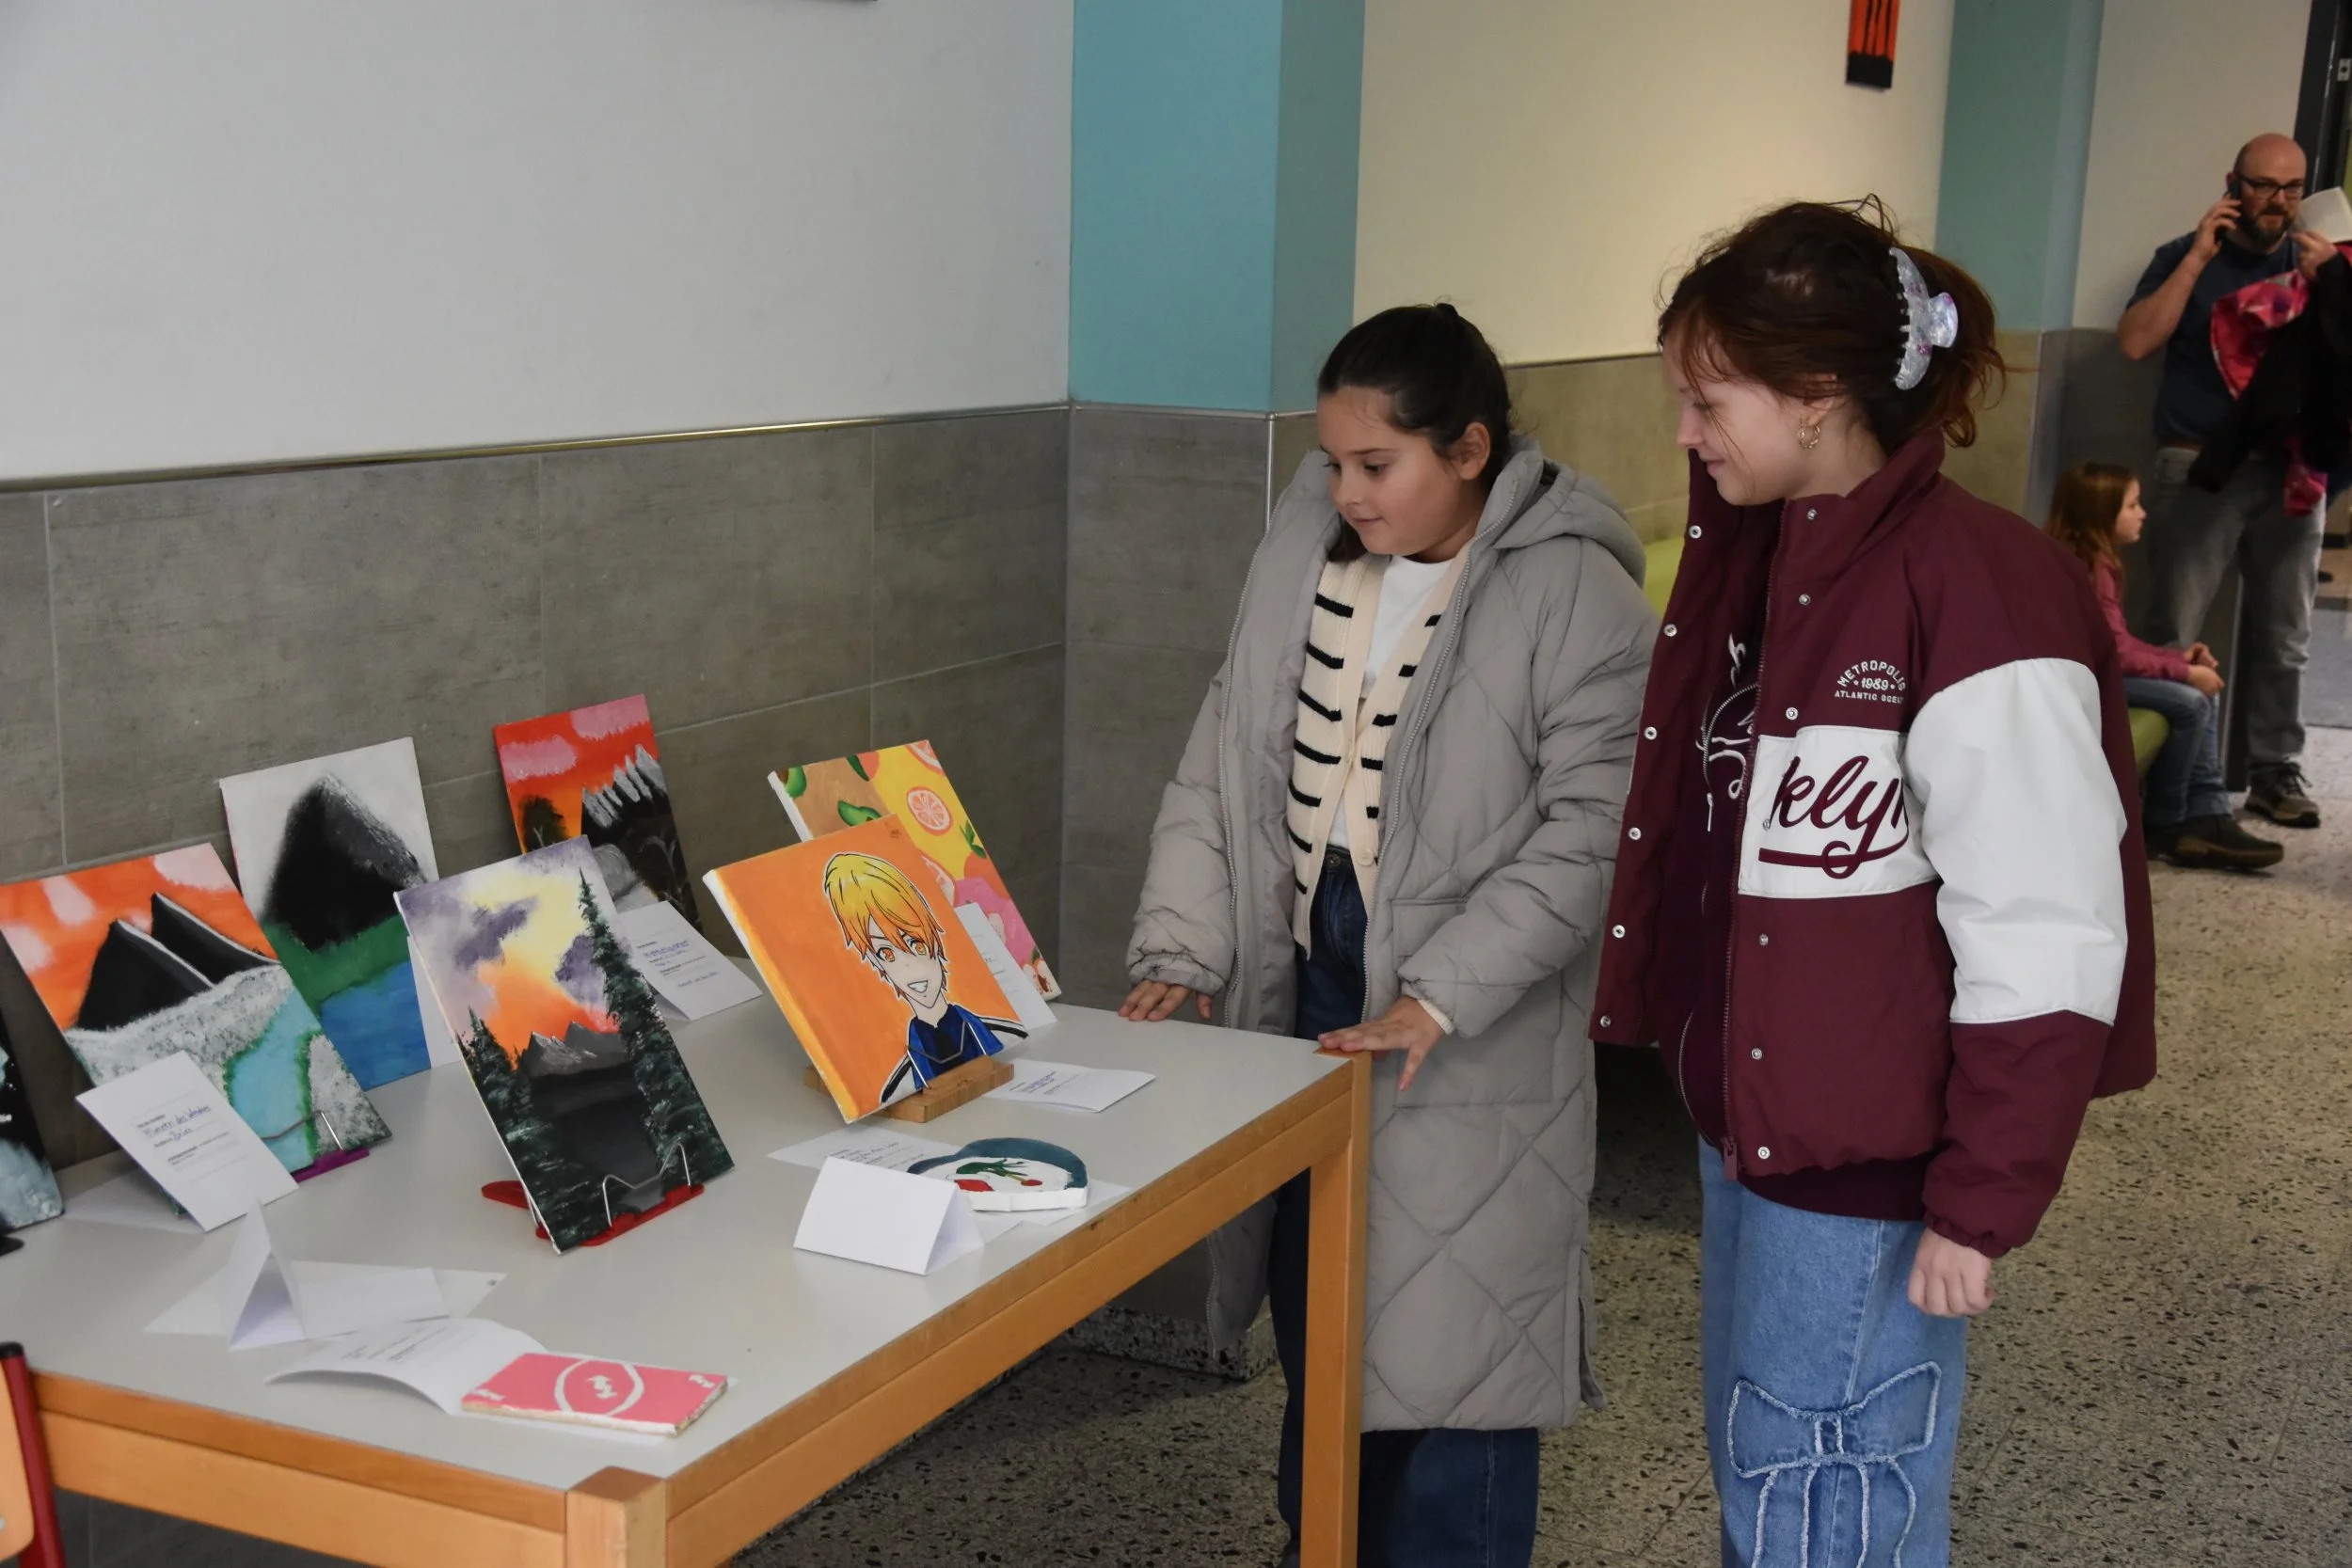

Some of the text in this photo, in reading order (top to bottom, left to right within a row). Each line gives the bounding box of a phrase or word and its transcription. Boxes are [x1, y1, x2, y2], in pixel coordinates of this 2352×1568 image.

[1836, 659, 1906, 691] METROPOLIS
[1861, 677, 1889, 691] 1989
[1835, 689, 1878, 701] ATLANTIC
